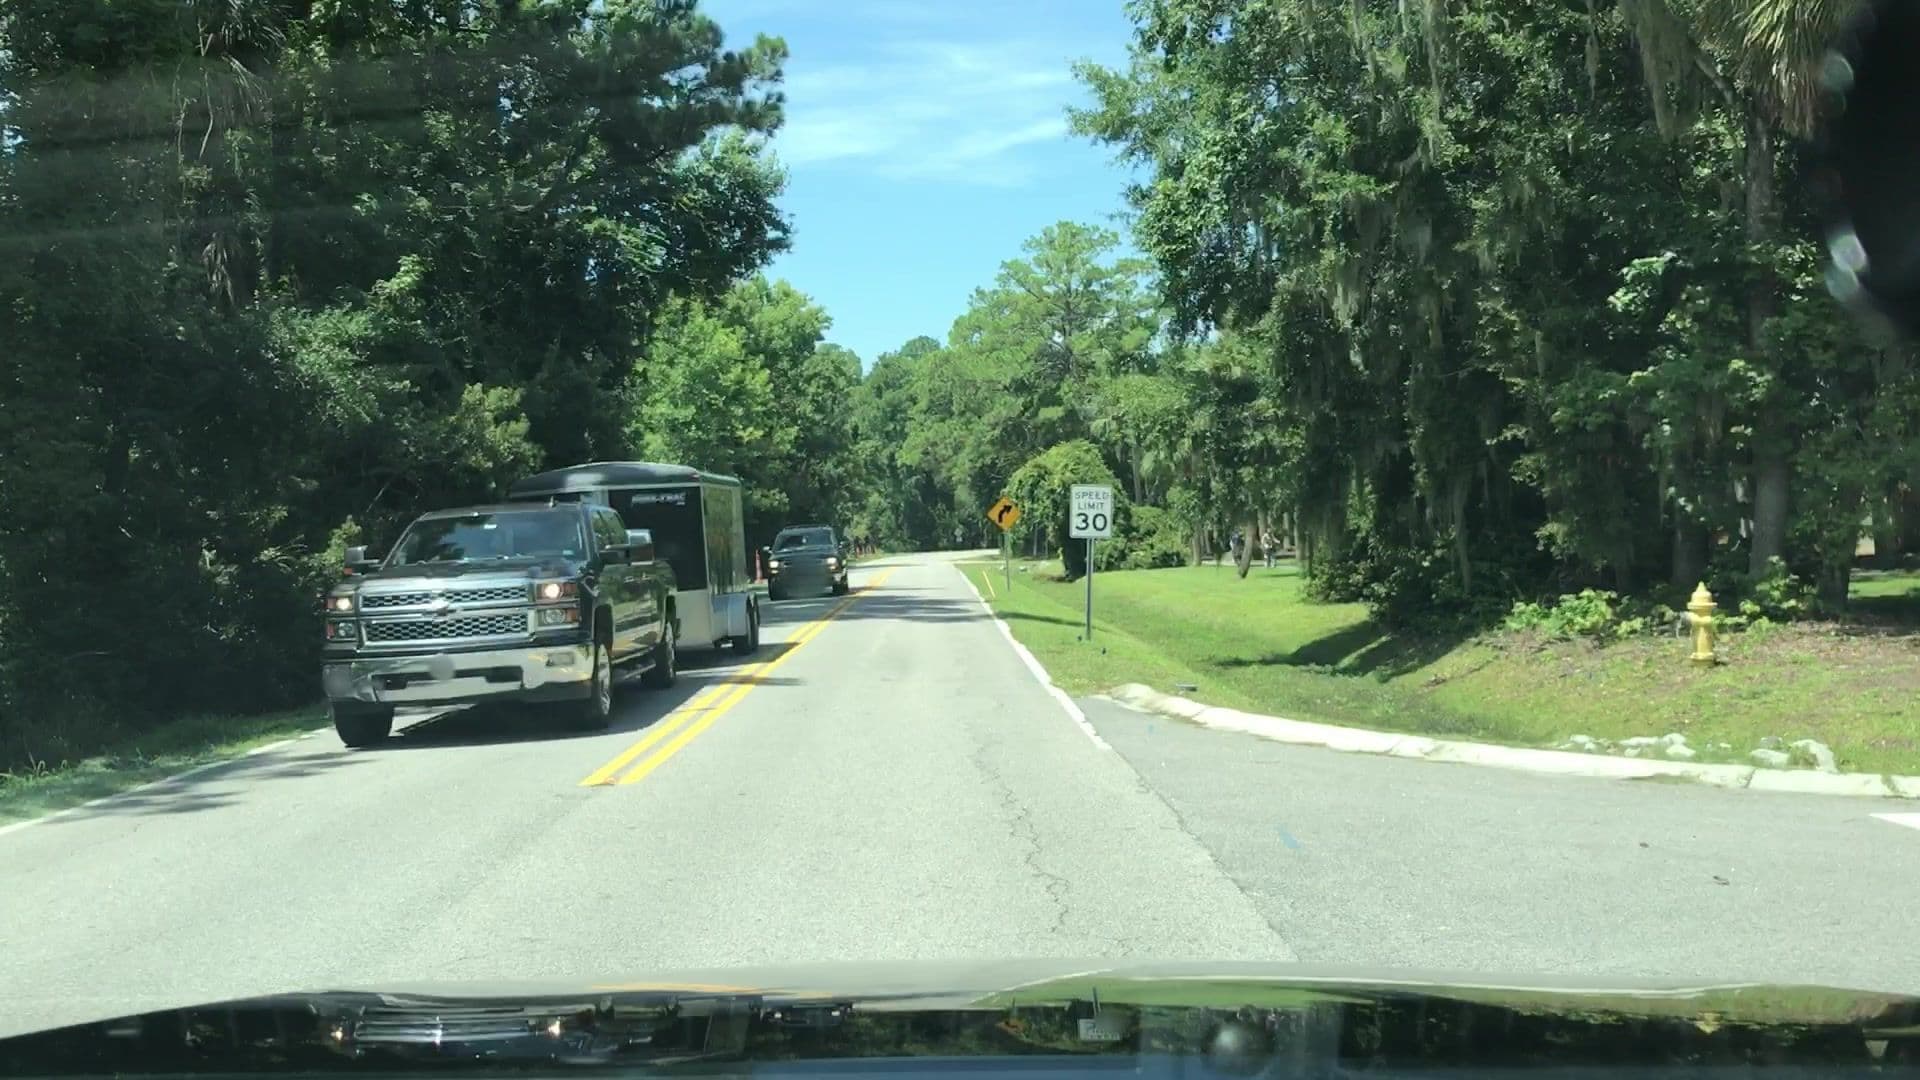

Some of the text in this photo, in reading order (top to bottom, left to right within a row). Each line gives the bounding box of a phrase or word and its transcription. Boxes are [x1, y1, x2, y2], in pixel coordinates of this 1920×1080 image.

[1075, 491, 1109, 500] SPEED
[1078, 502, 1104, 510] LIMIT
[1075, 512, 1107, 532] 30
